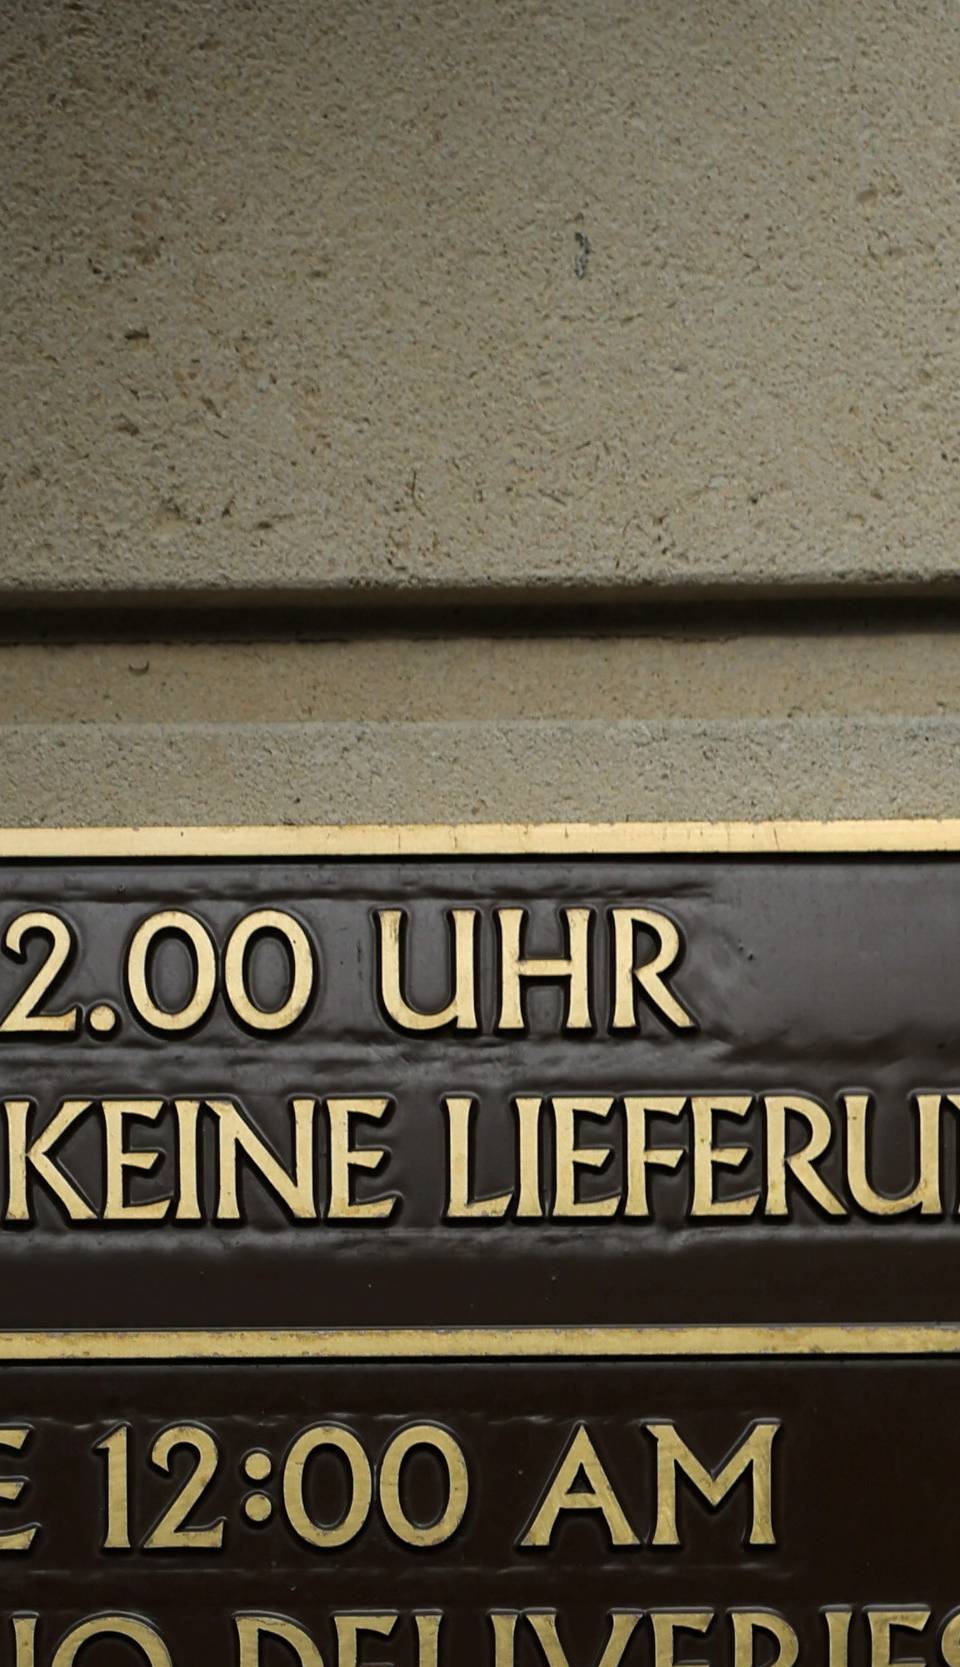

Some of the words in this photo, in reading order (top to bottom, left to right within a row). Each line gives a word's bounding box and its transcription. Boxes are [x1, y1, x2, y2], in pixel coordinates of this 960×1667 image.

[380, 908, 695, 1030] UHR
[5, 1099, 395, 1220] KEINE
[447, 1094, 960, 1216] LIEFERU
[101, 1425, 468, 1548] 12:00
[522, 1424, 780, 1546] AM
